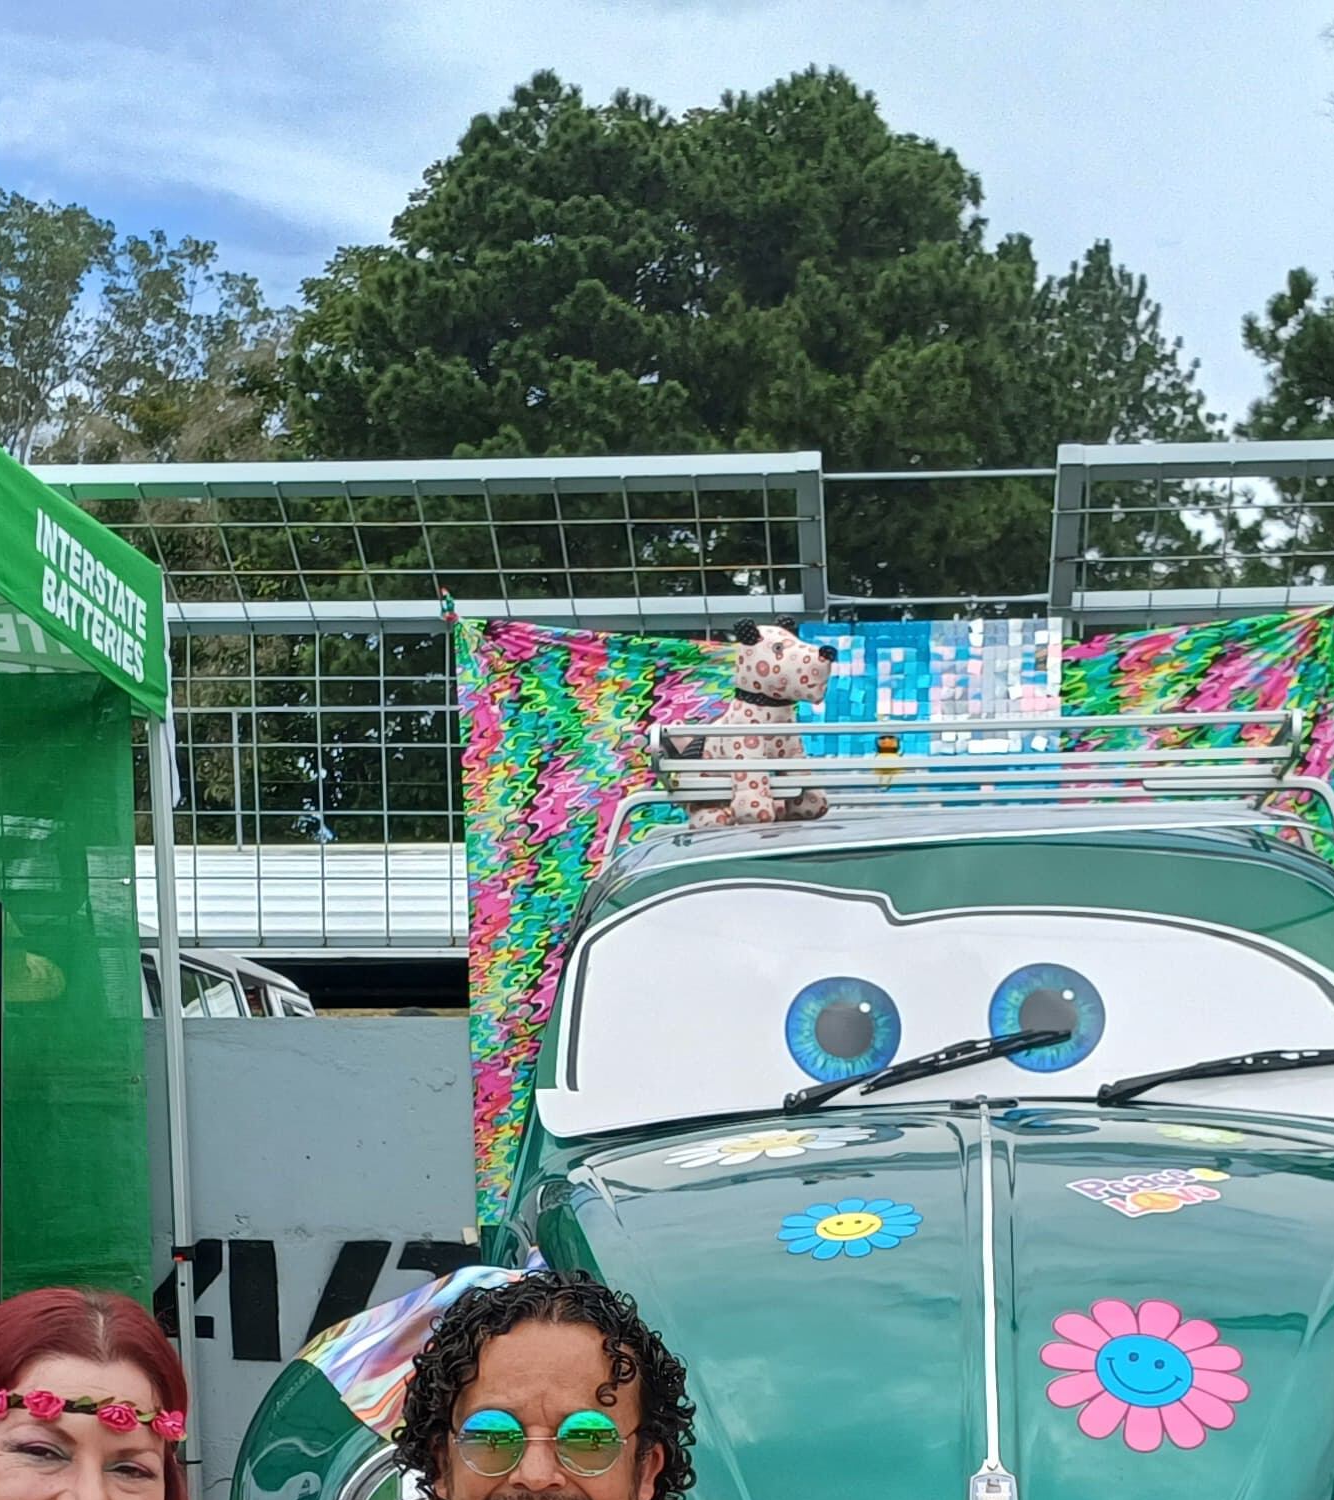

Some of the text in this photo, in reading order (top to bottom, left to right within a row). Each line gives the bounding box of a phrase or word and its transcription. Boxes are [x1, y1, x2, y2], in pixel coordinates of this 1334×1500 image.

[35, 508, 147, 641] INTERSTATE
[42, 565, 145, 683] BATTERIES
[1072, 1169, 1193, 1199] Peace
